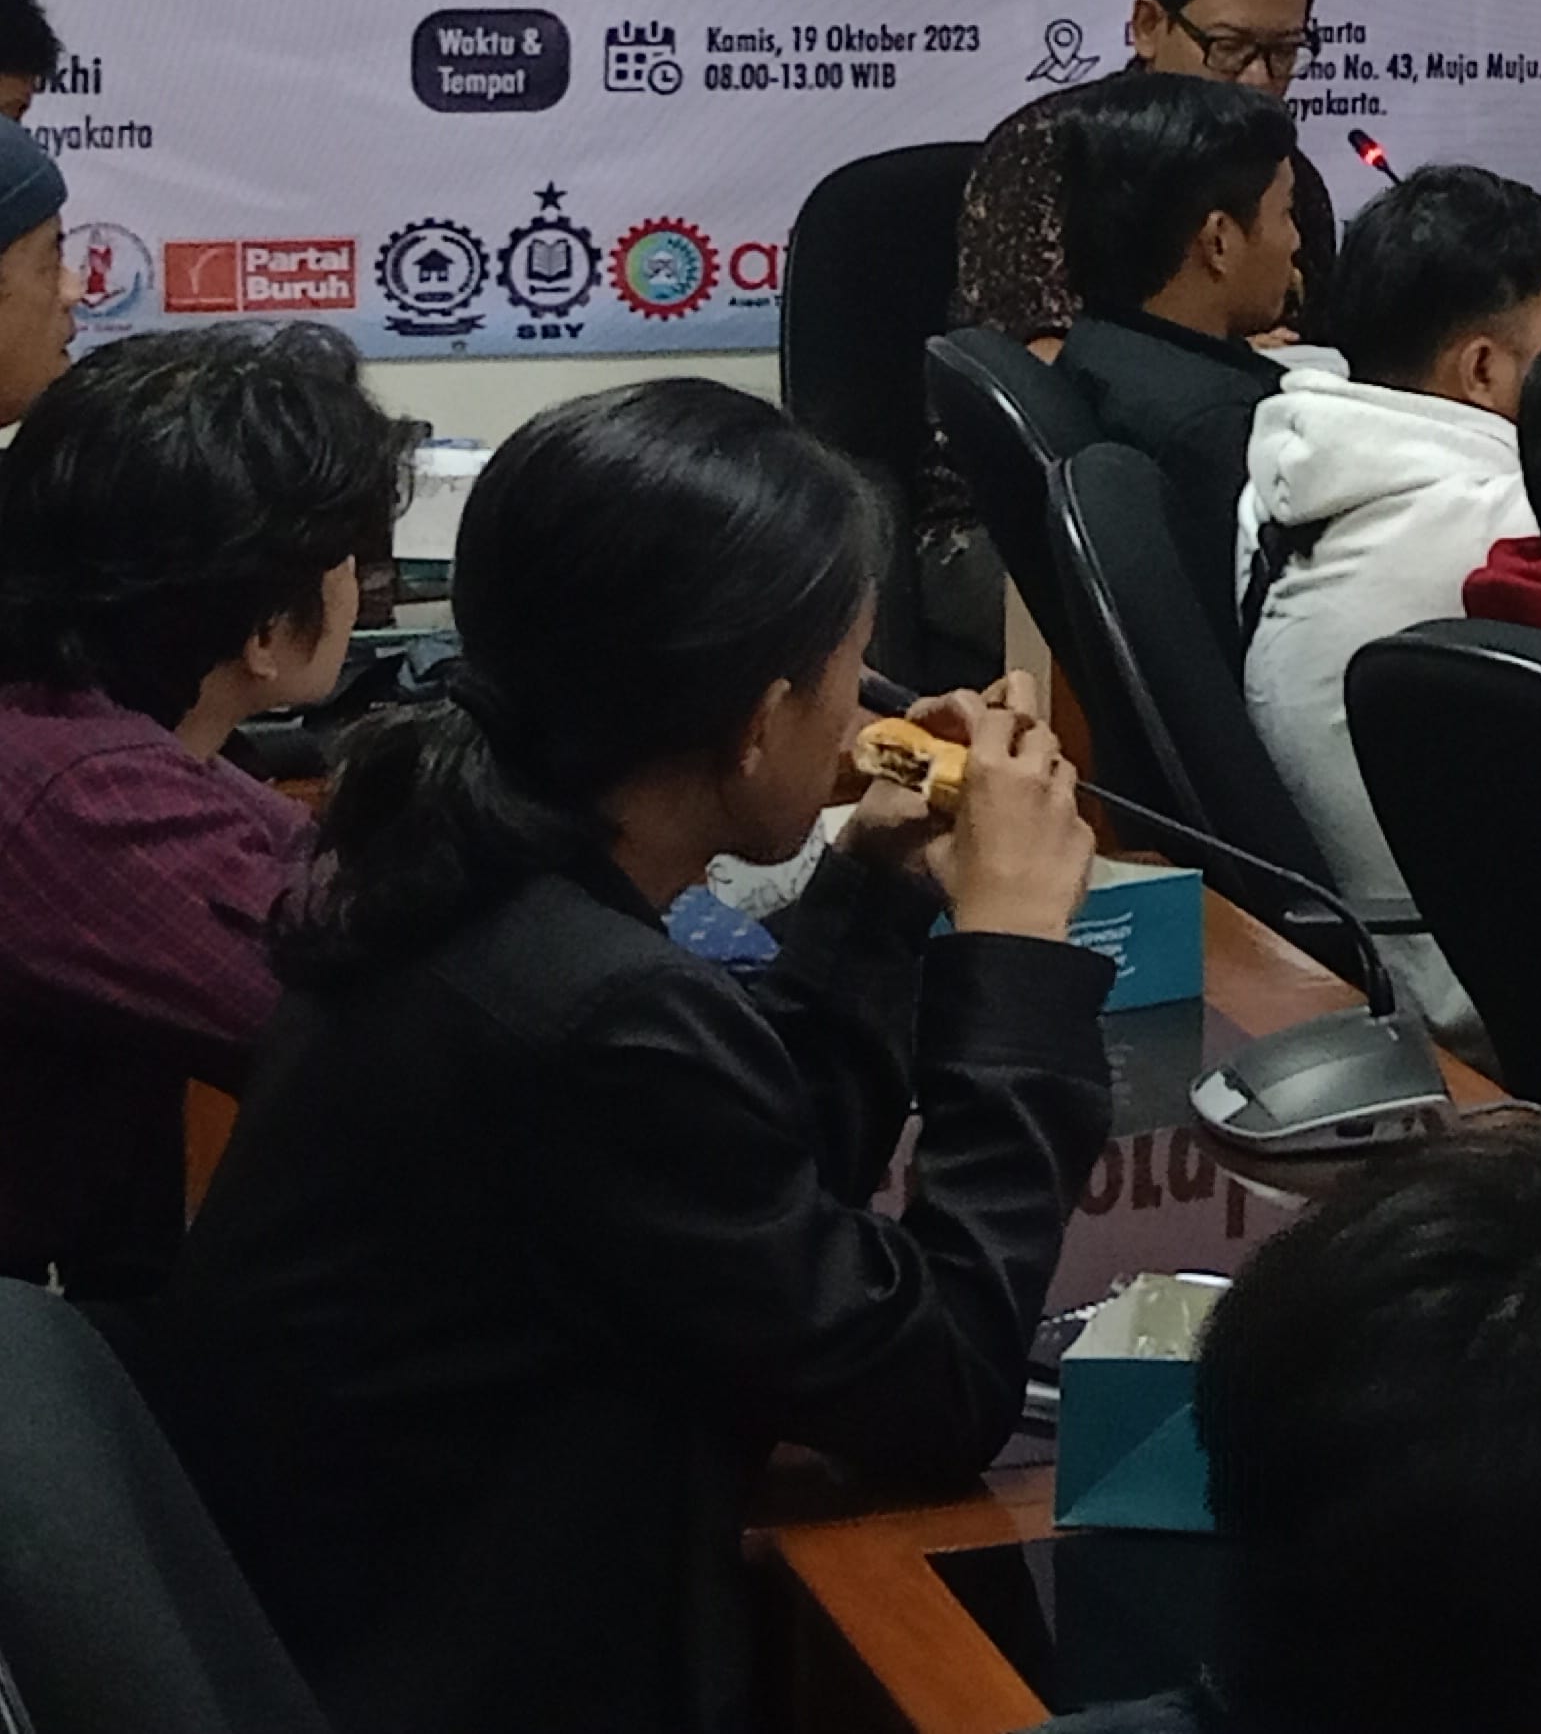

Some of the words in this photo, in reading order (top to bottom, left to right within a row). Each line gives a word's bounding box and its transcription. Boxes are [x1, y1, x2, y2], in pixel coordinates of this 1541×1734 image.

[437, 28, 513, 57] Waktu
[521, 28, 542, 57] &
[706, 26, 783, 58] Kamis,
[792, 27, 817, 51] 19
[827, 24, 915, 52] Oktober
[923, 27, 980, 51] 2023
[437, 67, 525, 97] Tempat
[705, 63, 843, 90] 08.00-13.00
[851, 63, 896, 88] WIB
[1344, 54, 1380, 80] No.
[1386, 54, 1418, 83] 43,
[1426, 53, 1478, 85] Muja
[246, 248, 350, 272] Partai
[246, 278, 350, 301] Buruh
